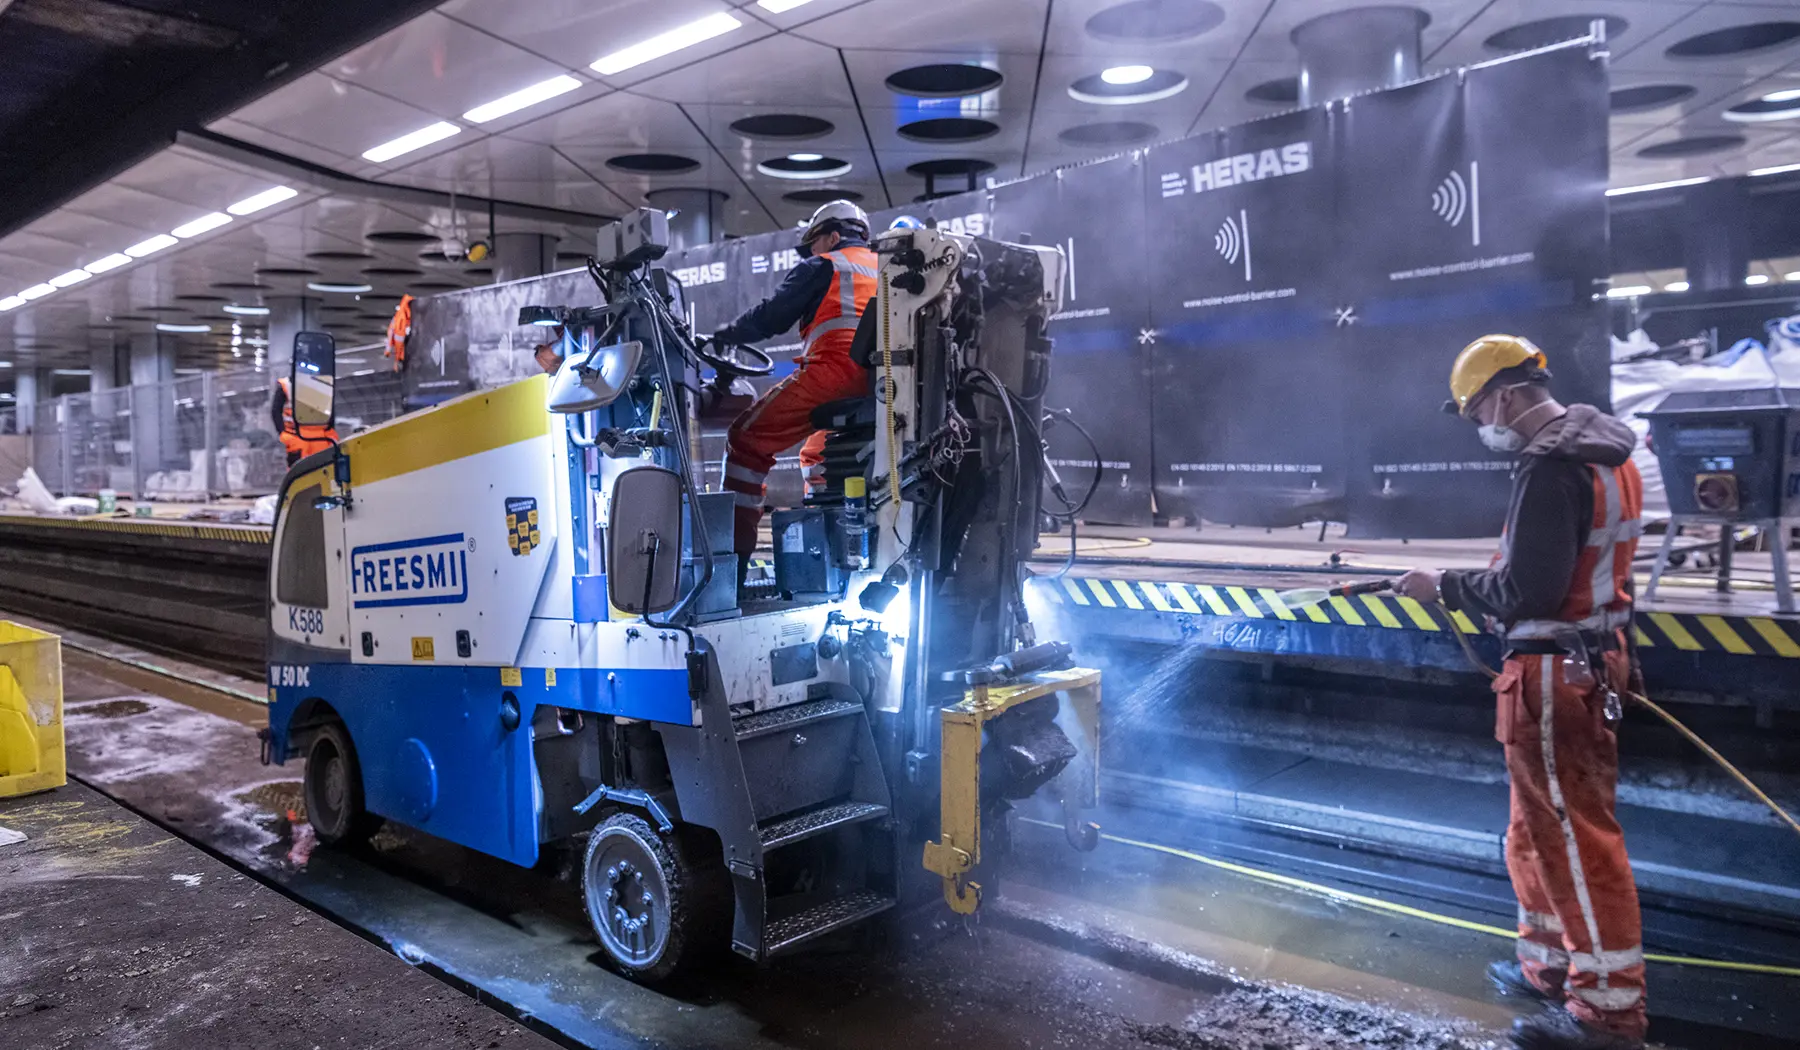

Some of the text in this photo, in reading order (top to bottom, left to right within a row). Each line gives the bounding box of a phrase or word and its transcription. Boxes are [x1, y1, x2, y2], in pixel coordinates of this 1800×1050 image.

[1192, 141, 1309, 193] HERAS
[1183, 287, 1297, 308] www.noise-control-barrier.com
[288, 606, 323, 634] K588
[270, 665, 310, 687] W 50 DC
